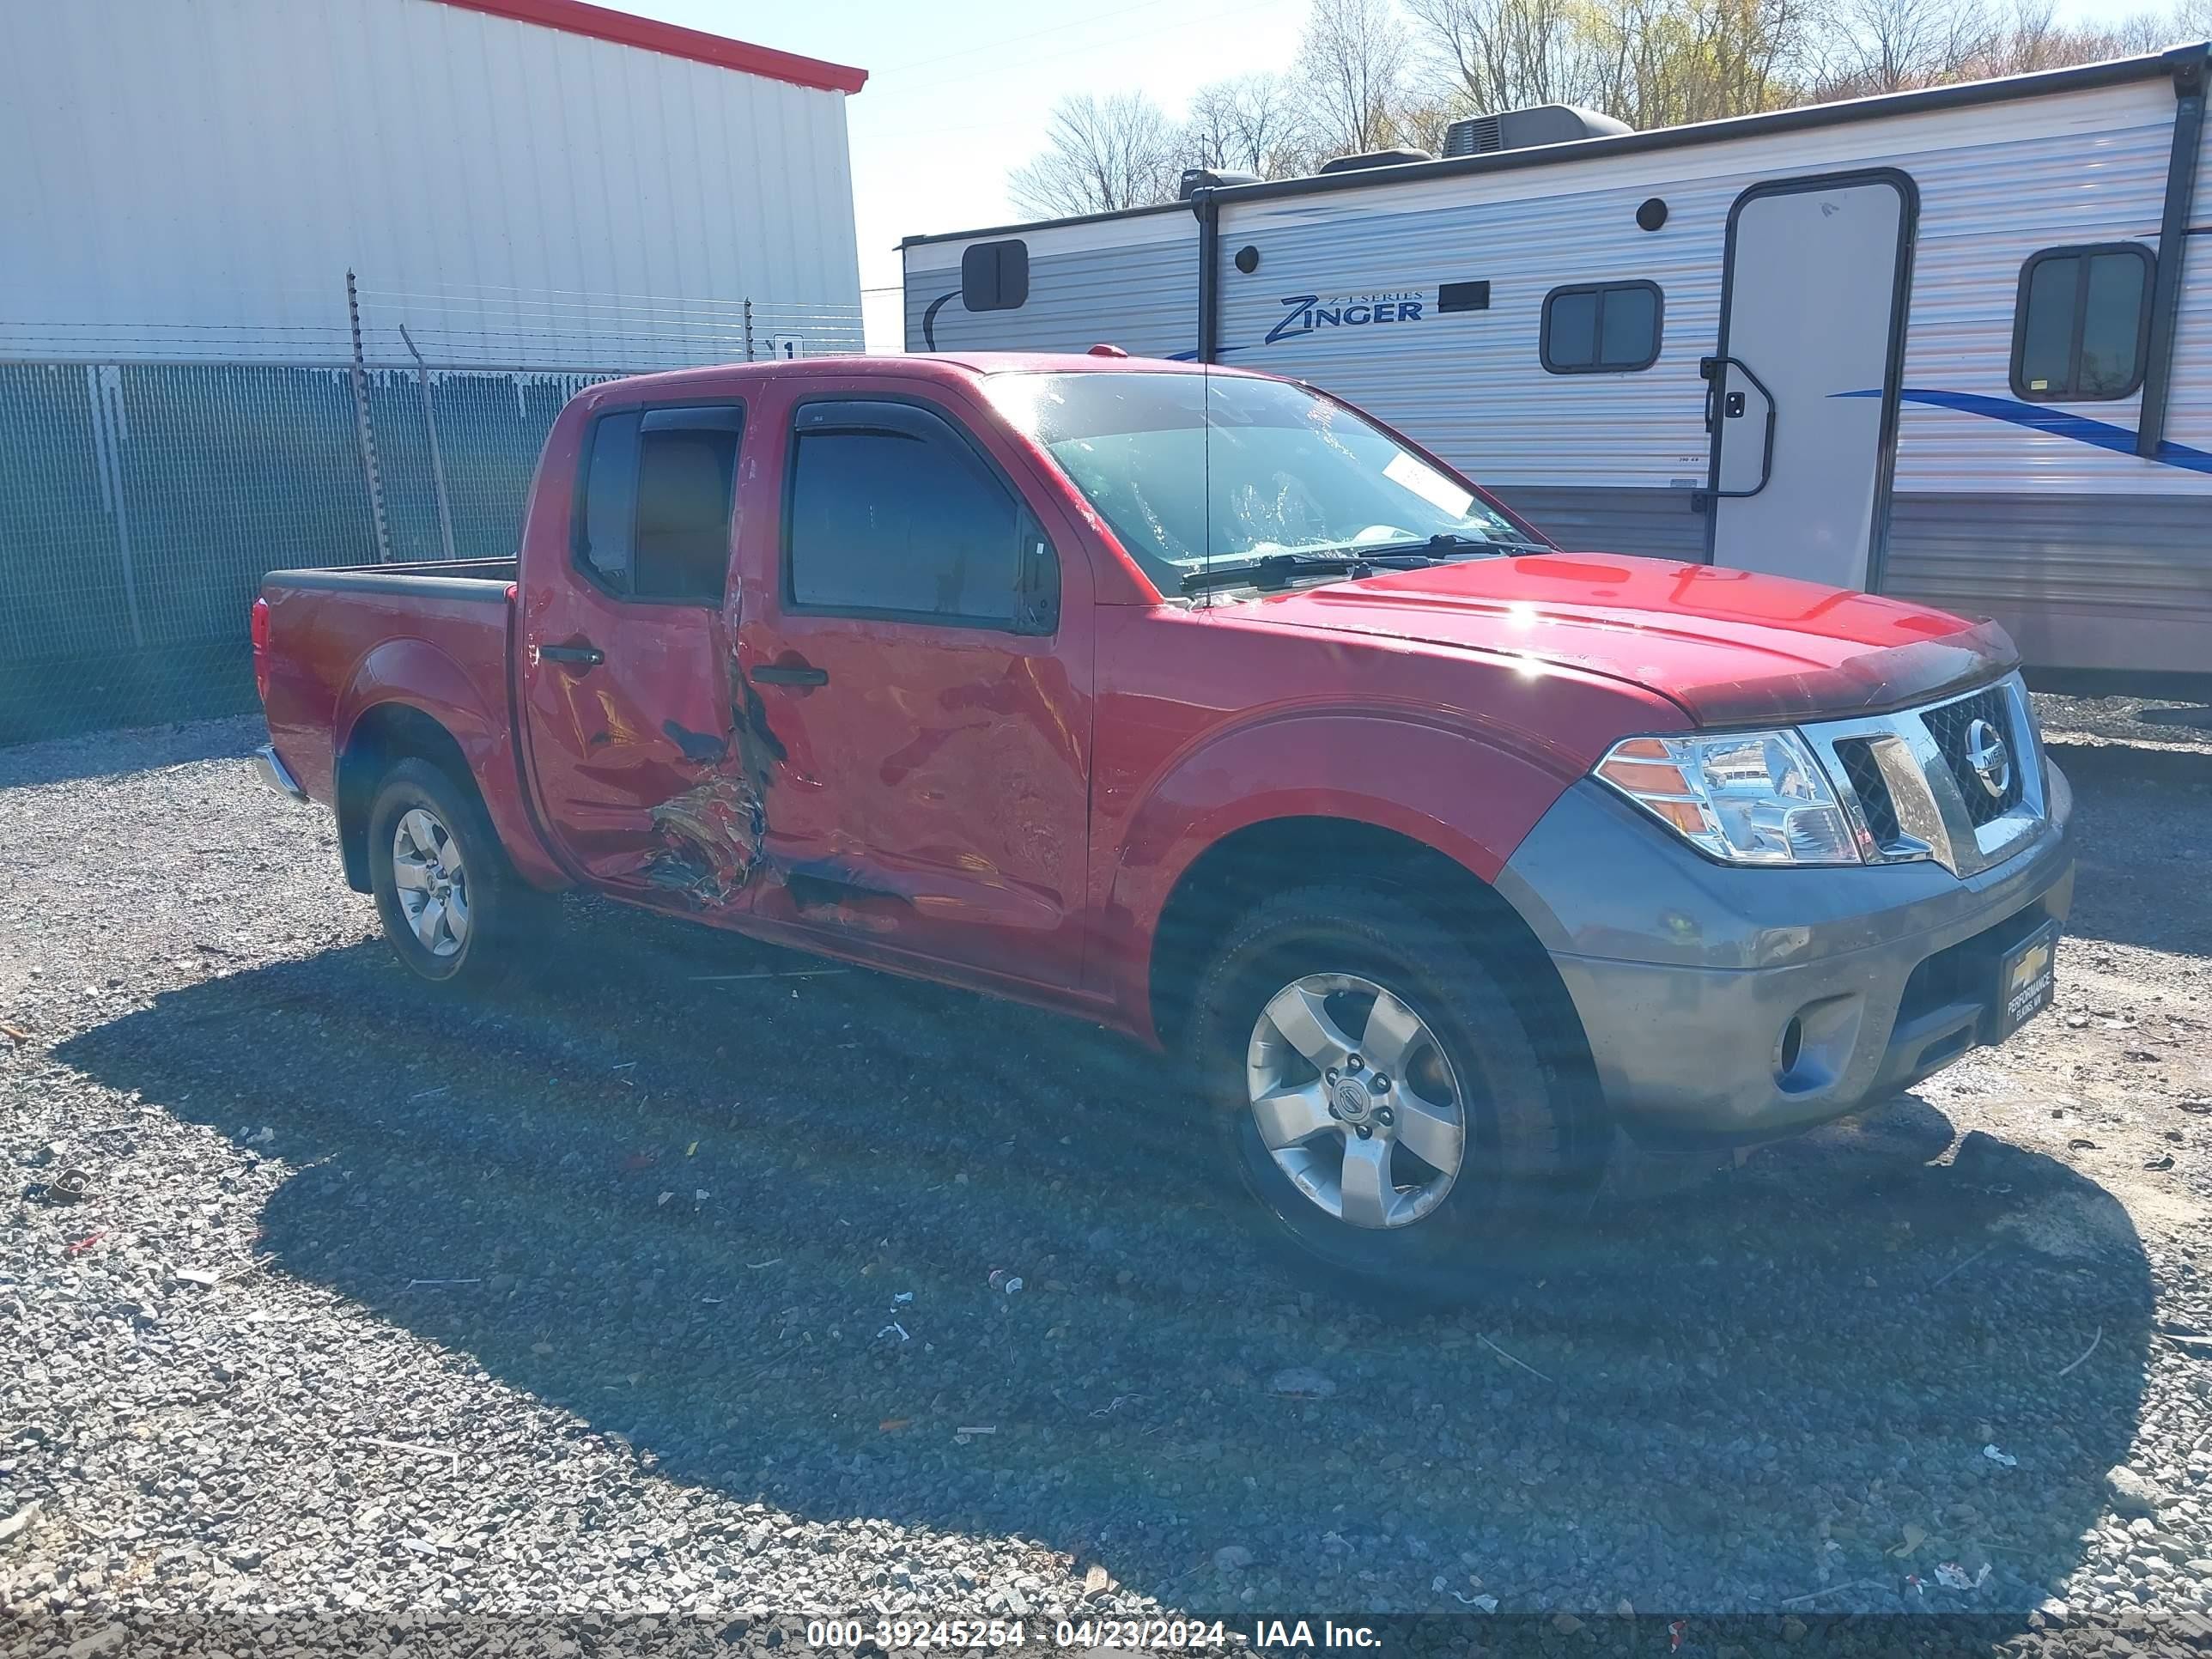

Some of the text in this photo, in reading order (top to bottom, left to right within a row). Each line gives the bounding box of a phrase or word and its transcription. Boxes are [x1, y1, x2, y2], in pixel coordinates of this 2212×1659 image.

[1360, 291, 1423, 303] SERIES
[1265, 295, 1423, 345] ZINGER
[784, 342, 793, 359] 1
[2008, 971, 2051, 1017] PERFORMANCE
